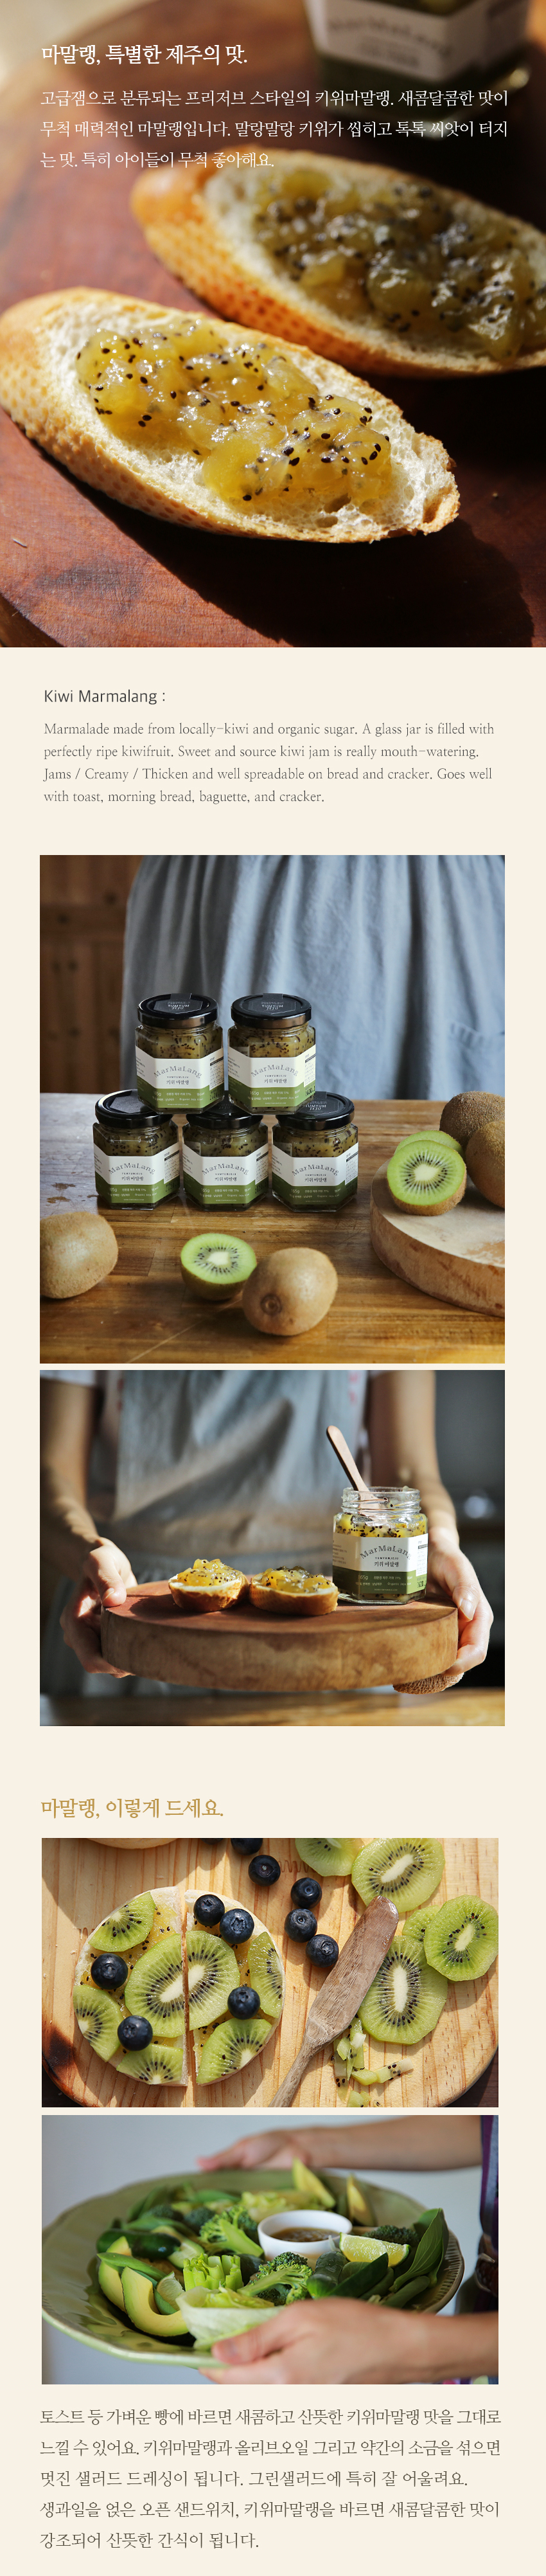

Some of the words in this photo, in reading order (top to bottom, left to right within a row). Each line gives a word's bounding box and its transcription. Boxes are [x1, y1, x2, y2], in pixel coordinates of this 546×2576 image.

[154, 1066, 202, 1079] MarMaLang
[251, 1065, 299, 1077] MarMaLang
[109, 1163, 155, 1175] MarMaLang
[202, 1164, 249, 1175] MarMaLang
[292, 1164, 339, 1176] MarMaLang
[360, 1545, 411, 1560] MarMaLang
